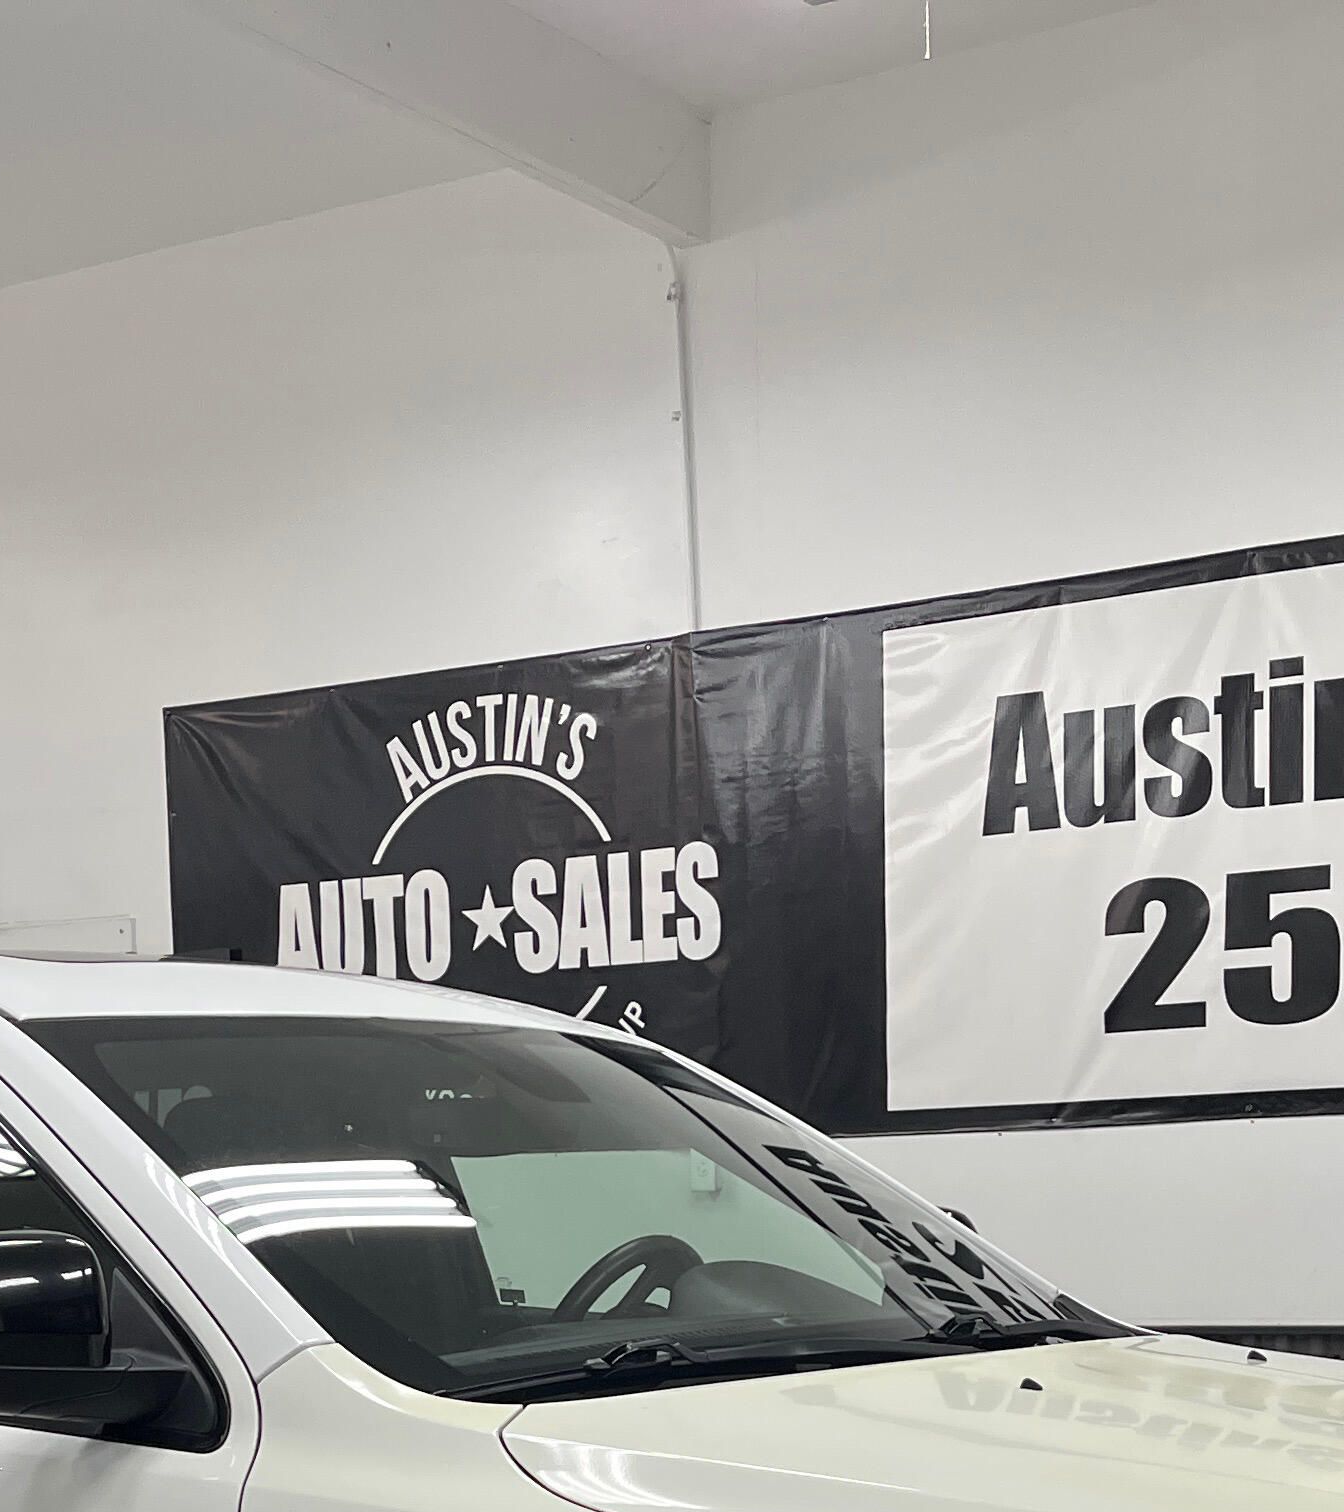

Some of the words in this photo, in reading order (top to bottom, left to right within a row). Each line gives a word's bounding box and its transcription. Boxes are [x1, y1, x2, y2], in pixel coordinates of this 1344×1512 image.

[385, 692, 597, 803] AUSTIN'S
[277, 868, 451, 983] AUTO
[512, 840, 721, 975] SALES
